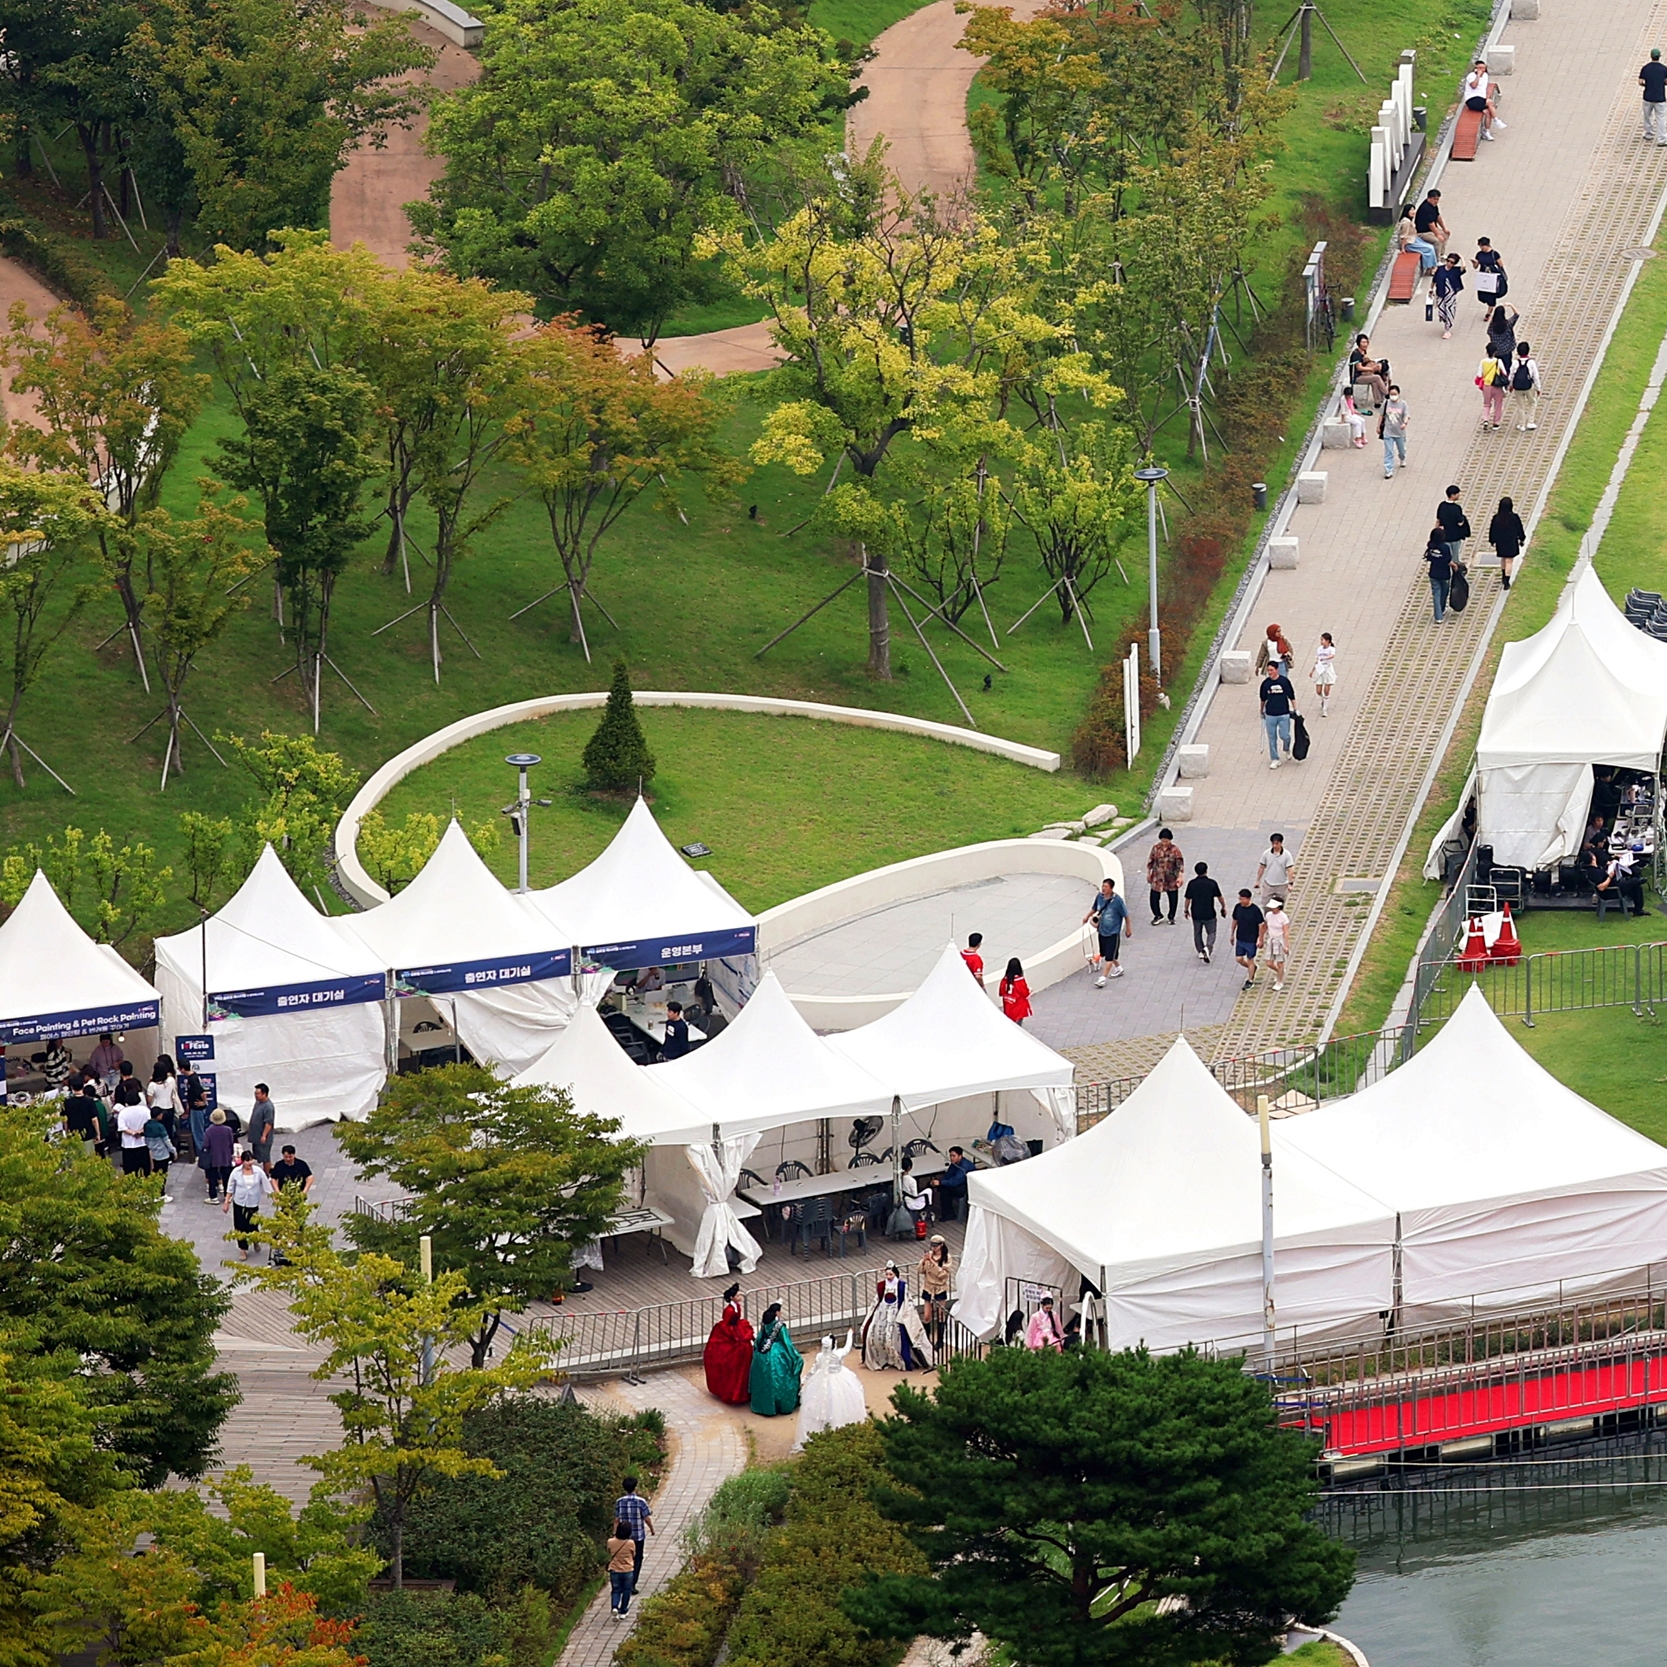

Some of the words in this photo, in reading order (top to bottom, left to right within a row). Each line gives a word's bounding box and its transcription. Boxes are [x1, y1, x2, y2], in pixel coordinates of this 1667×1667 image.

[661, 944, 703, 959] 운영본부
[464, 970, 497, 984] 출연자
[499, 965, 531, 979] 대기실
[277, 992, 309, 1007] 출연자
[312, 989, 345, 1003] 대기실
[12, 1027, 35, 1036] Face
[35, 1022, 71, 1033] Painting
[72, 1019, 80, 1027] &
[81, 1017, 96, 1027] Pet
[97, 1013, 119, 1024] Rock
[120, 1010, 156, 1022] Painting
